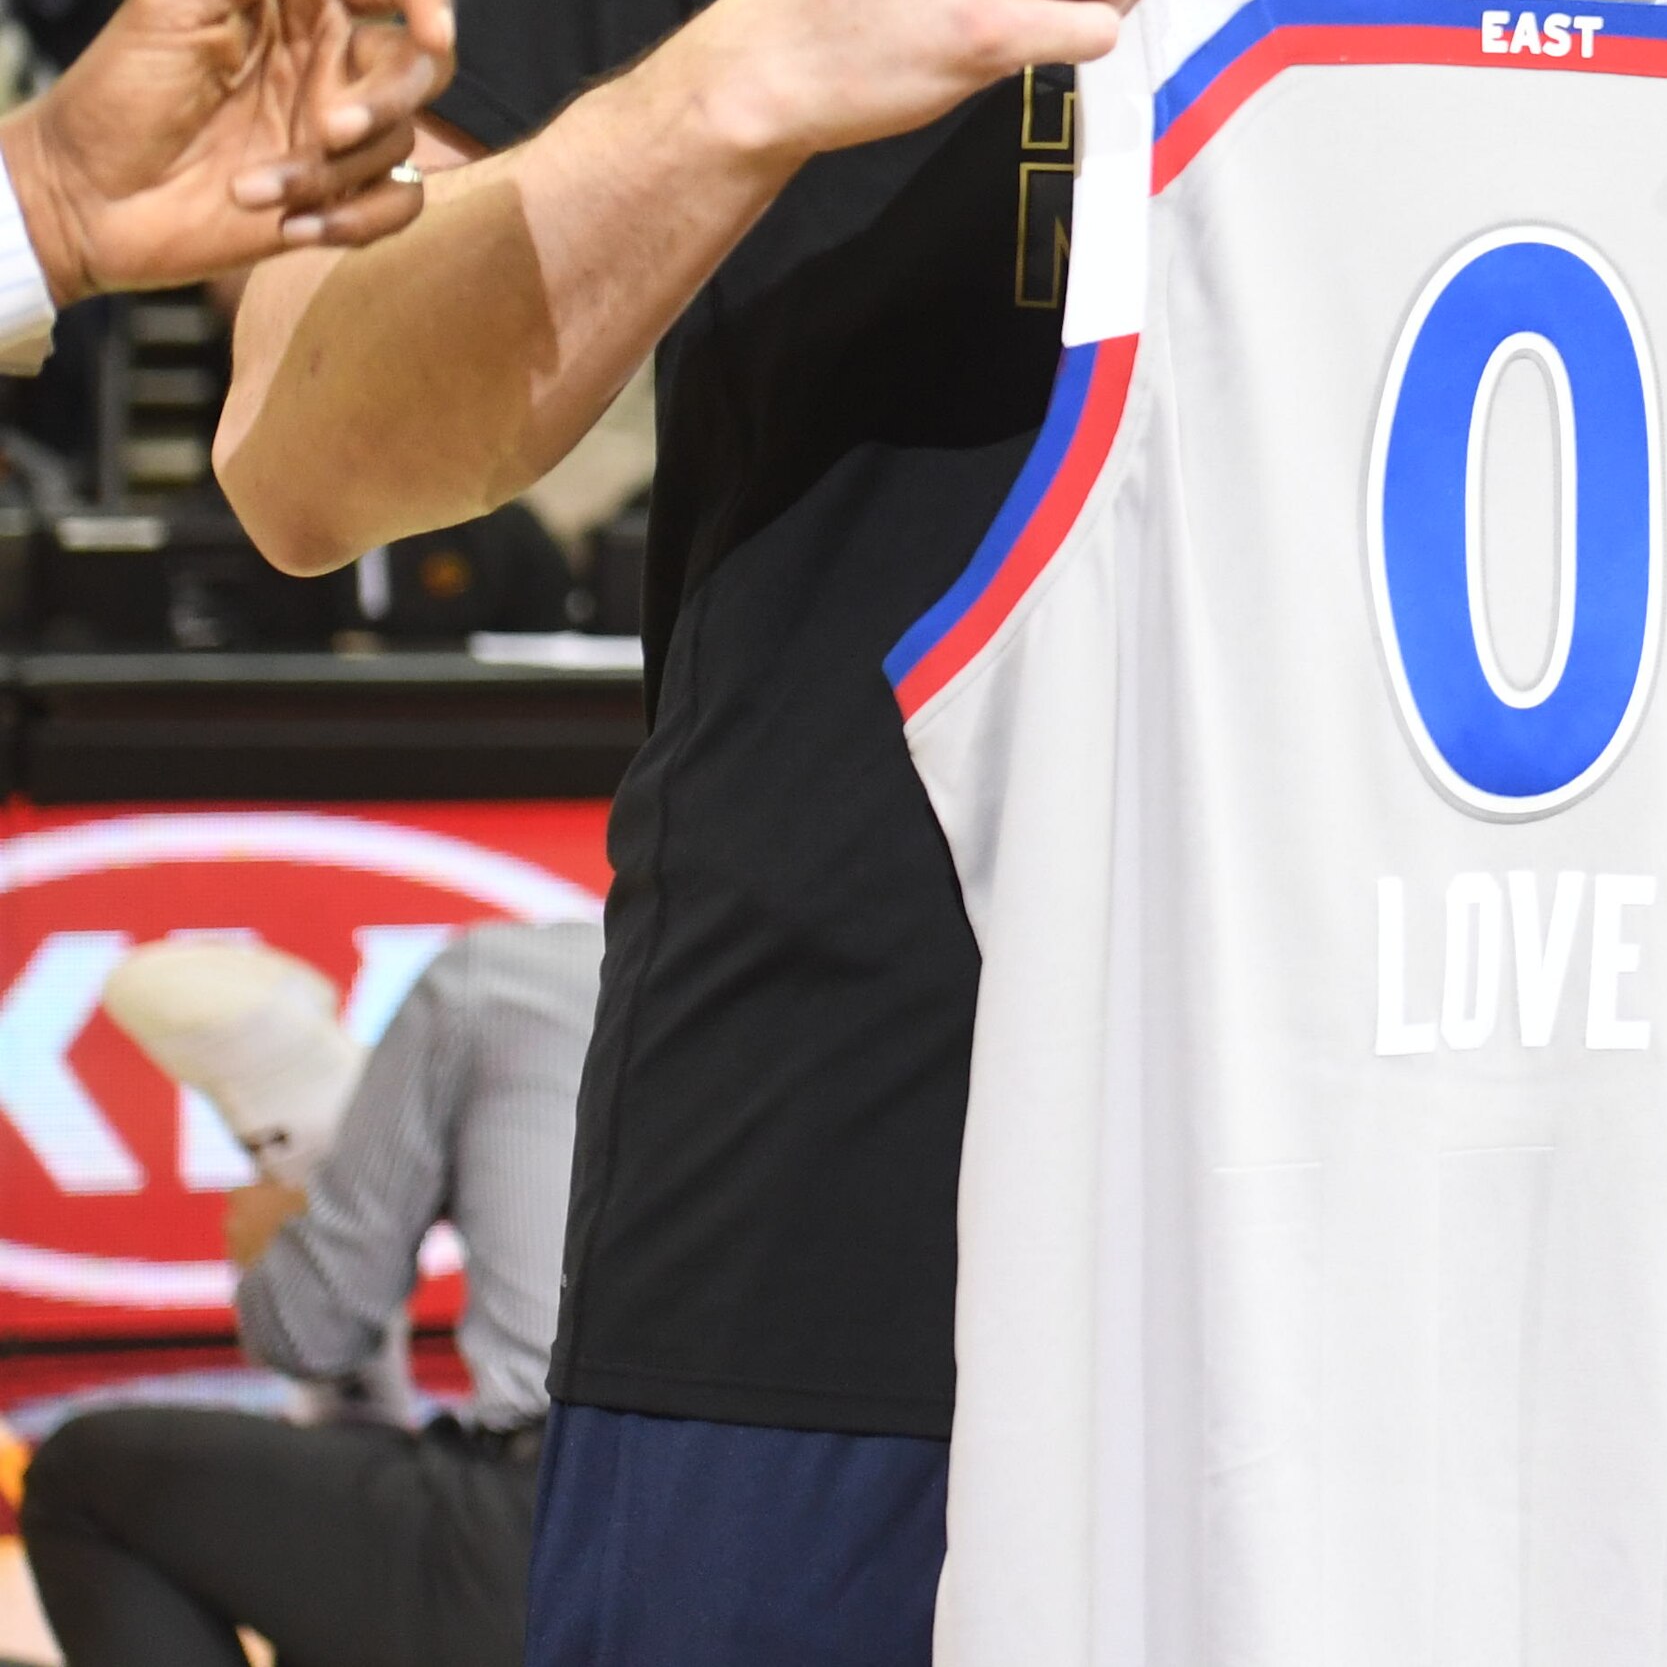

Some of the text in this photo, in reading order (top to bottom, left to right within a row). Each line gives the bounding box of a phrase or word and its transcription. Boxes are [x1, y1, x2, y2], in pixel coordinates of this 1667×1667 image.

[1481, 9, 1605, 59] EAST
[1366, 219, 1666, 825] 0
[1375, 869, 1657, 1055] LOVE
